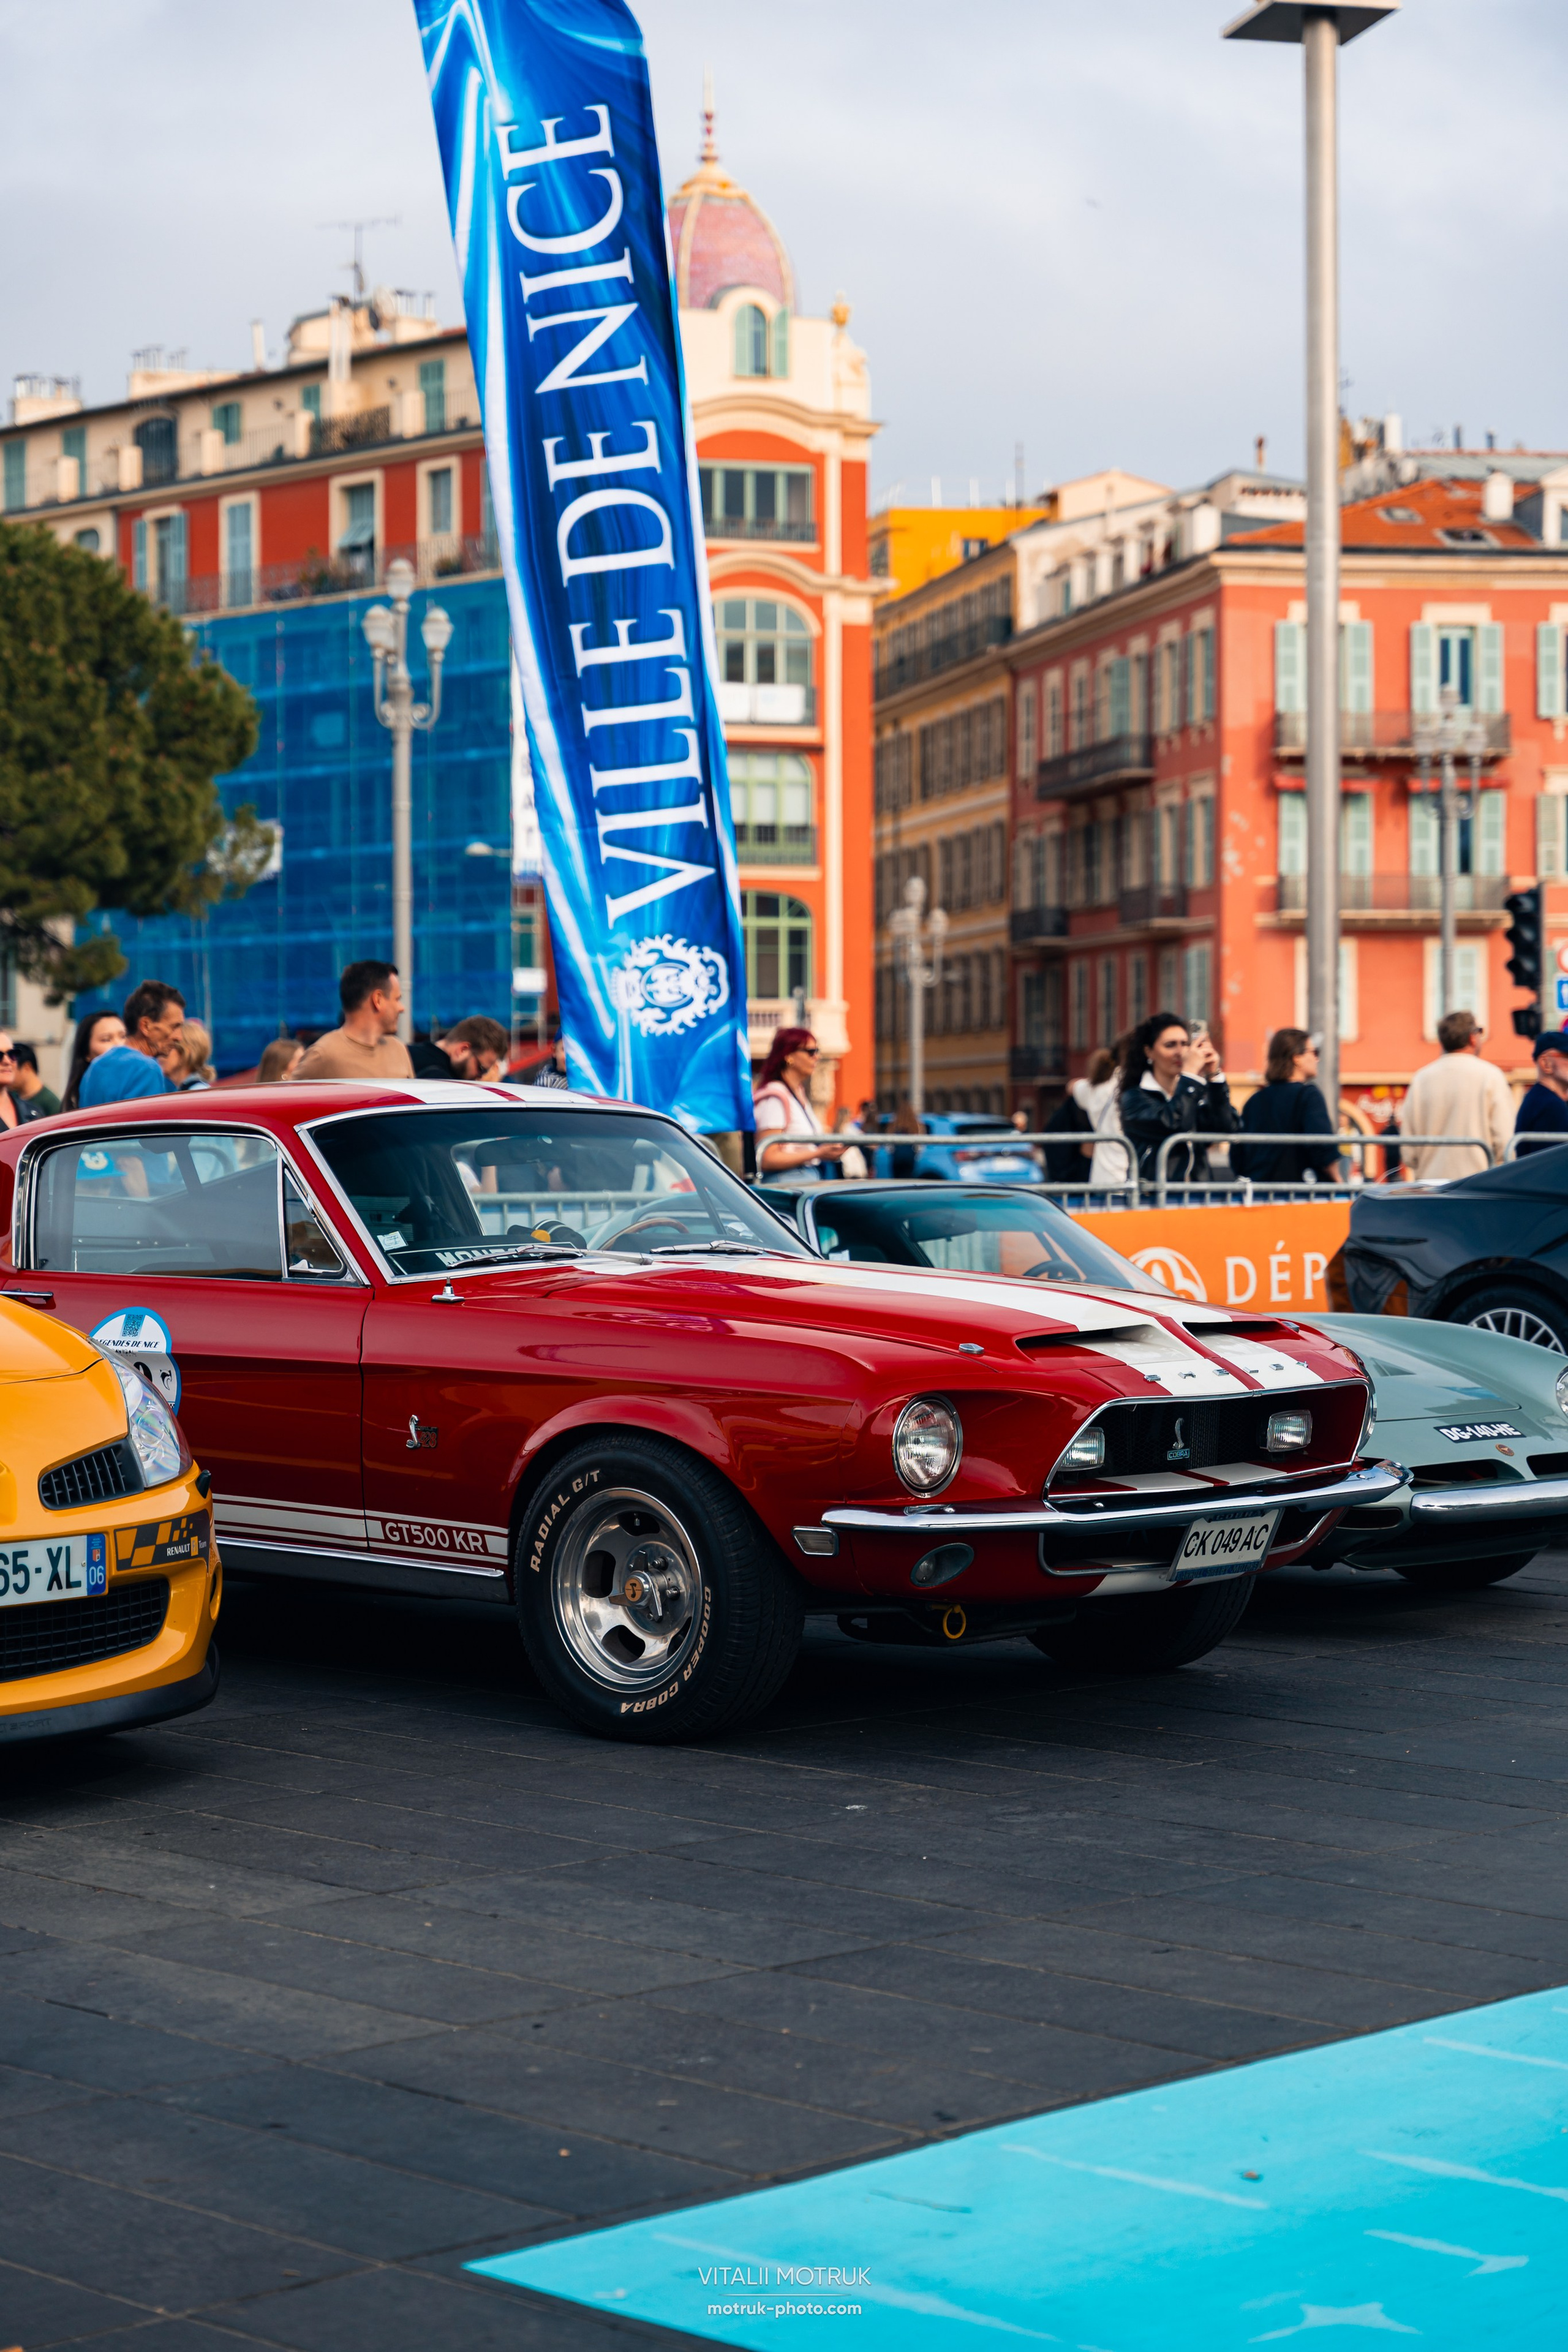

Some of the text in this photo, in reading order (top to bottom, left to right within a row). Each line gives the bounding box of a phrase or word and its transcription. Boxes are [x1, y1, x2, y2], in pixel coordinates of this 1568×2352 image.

[496, 104, 716, 929] VILLE DE NICE
[1225, 1240, 1329, 1305] DÉP
[96, 1339, 130, 1348] EGENDES
[419, 1431, 437, 1448] 428
[1439, 1423, 1521, 1441] DG-140-HE
[530, 1470, 600, 1573] RADIAL G/T
[1216, 1510, 1262, 1520] COBRA
[167, 1543, 190, 1556] RENAULT
[198, 1540, 207, 1549] Team
[385, 1522, 484, 1553] GT500 KR
[1184, 1524, 1269, 1558] CK 049 AC
[89, 1566, 105, 1585] 06
[620, 1586, 712, 1714] COOPER COBRA
